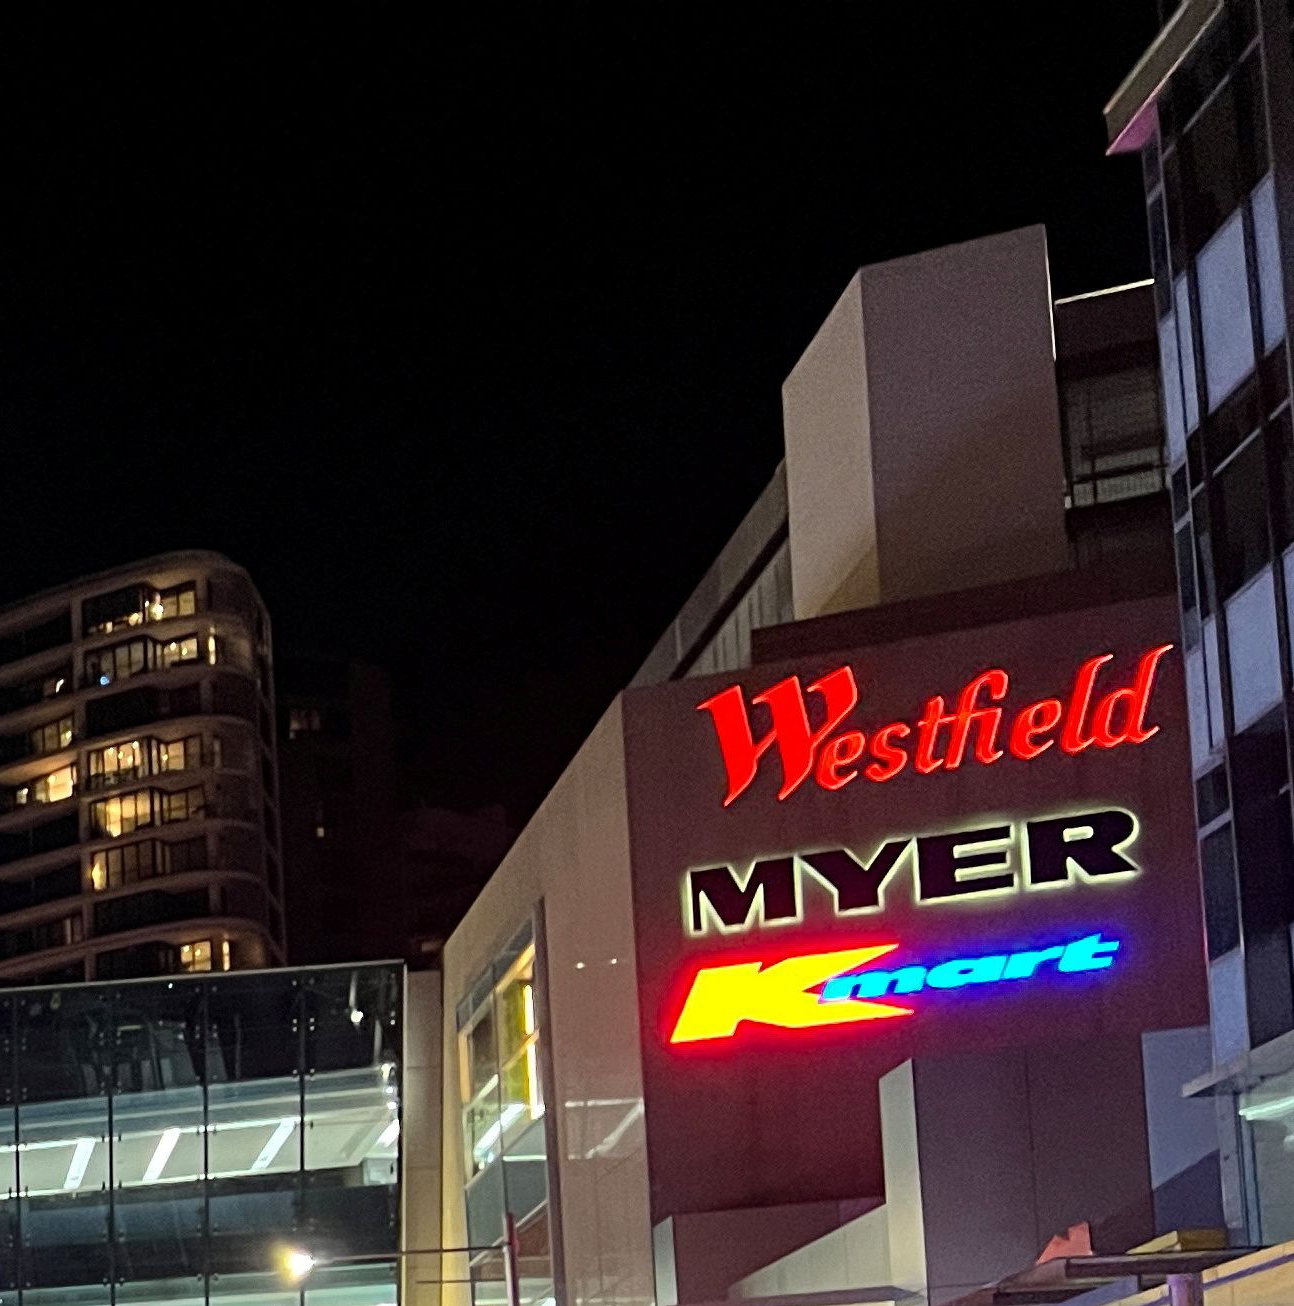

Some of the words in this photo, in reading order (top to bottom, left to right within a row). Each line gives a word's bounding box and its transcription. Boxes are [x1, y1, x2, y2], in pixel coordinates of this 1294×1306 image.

[697, 643, 1174, 806] Westfield
[685, 807, 1143, 938] MYER
[670, 932, 1121, 1044] Kmart
